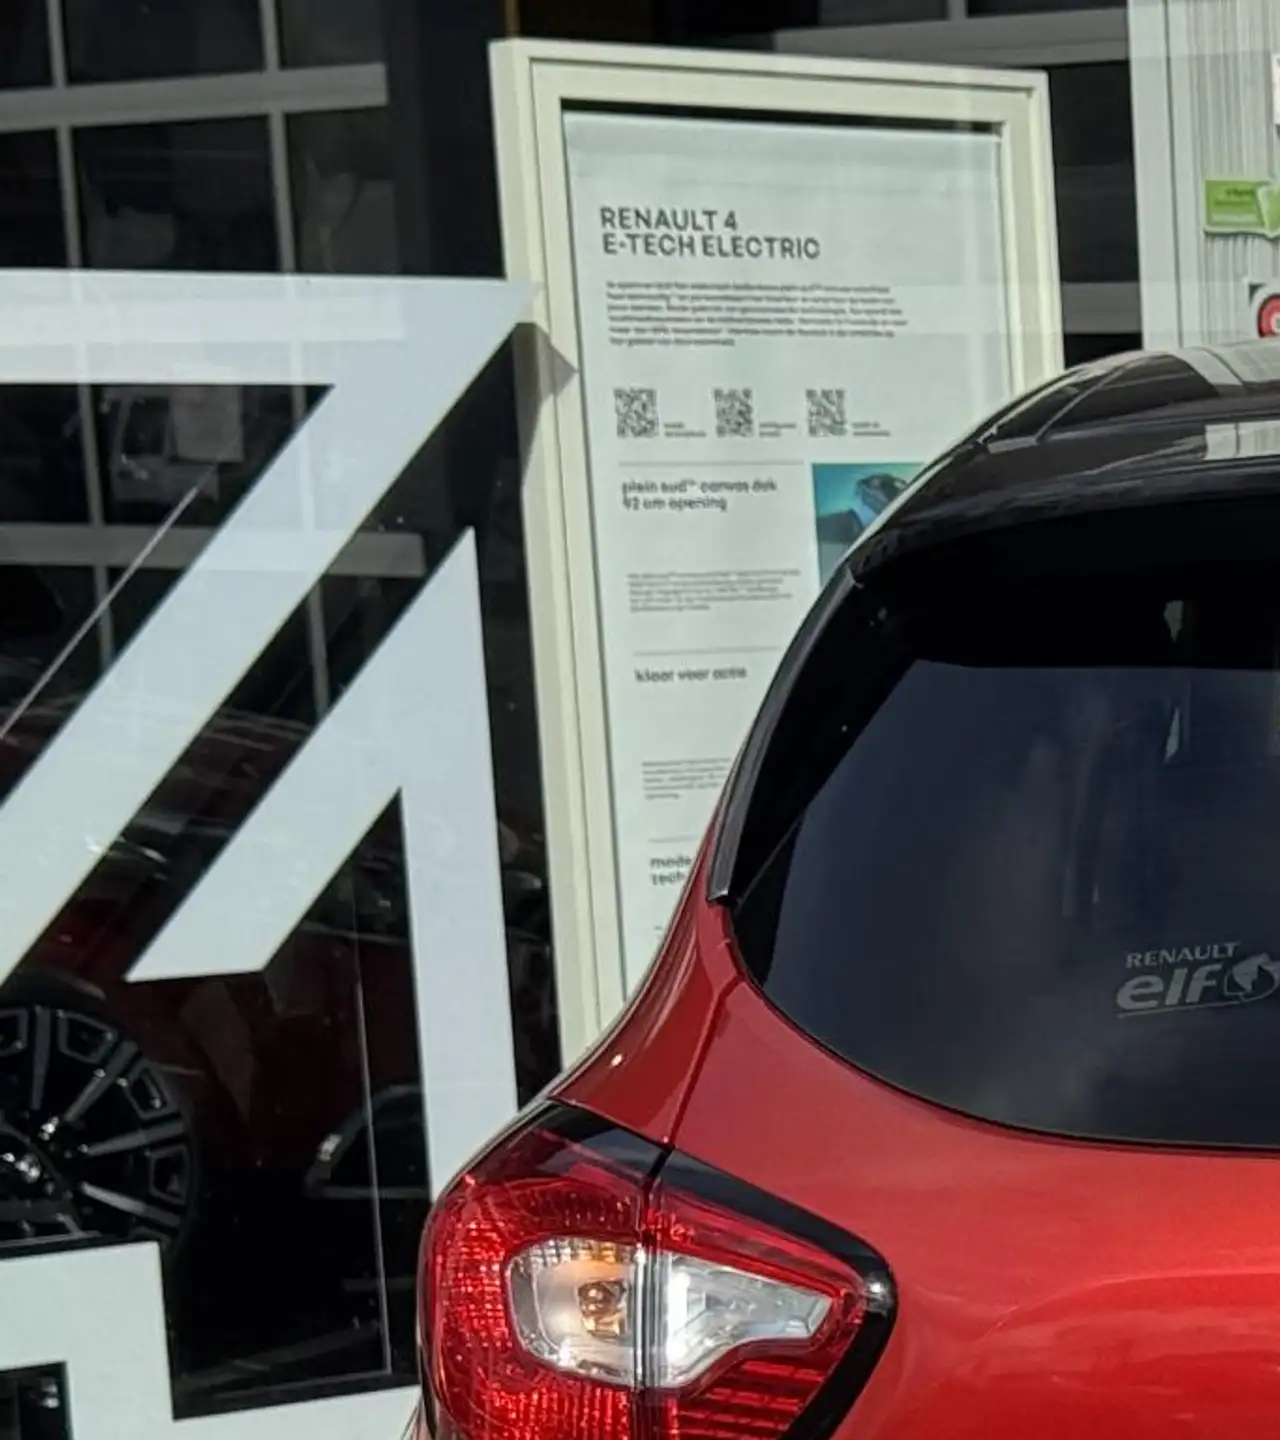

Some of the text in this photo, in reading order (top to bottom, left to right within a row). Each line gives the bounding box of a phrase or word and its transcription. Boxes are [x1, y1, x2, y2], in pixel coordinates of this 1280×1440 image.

[600, 206, 738, 231] RENAULT 4
[602, 232, 821, 260] E-TECH ELECTRIC
[1126, 941, 1242, 969] RENAULT
[1116, 963, 1223, 1010] elf
